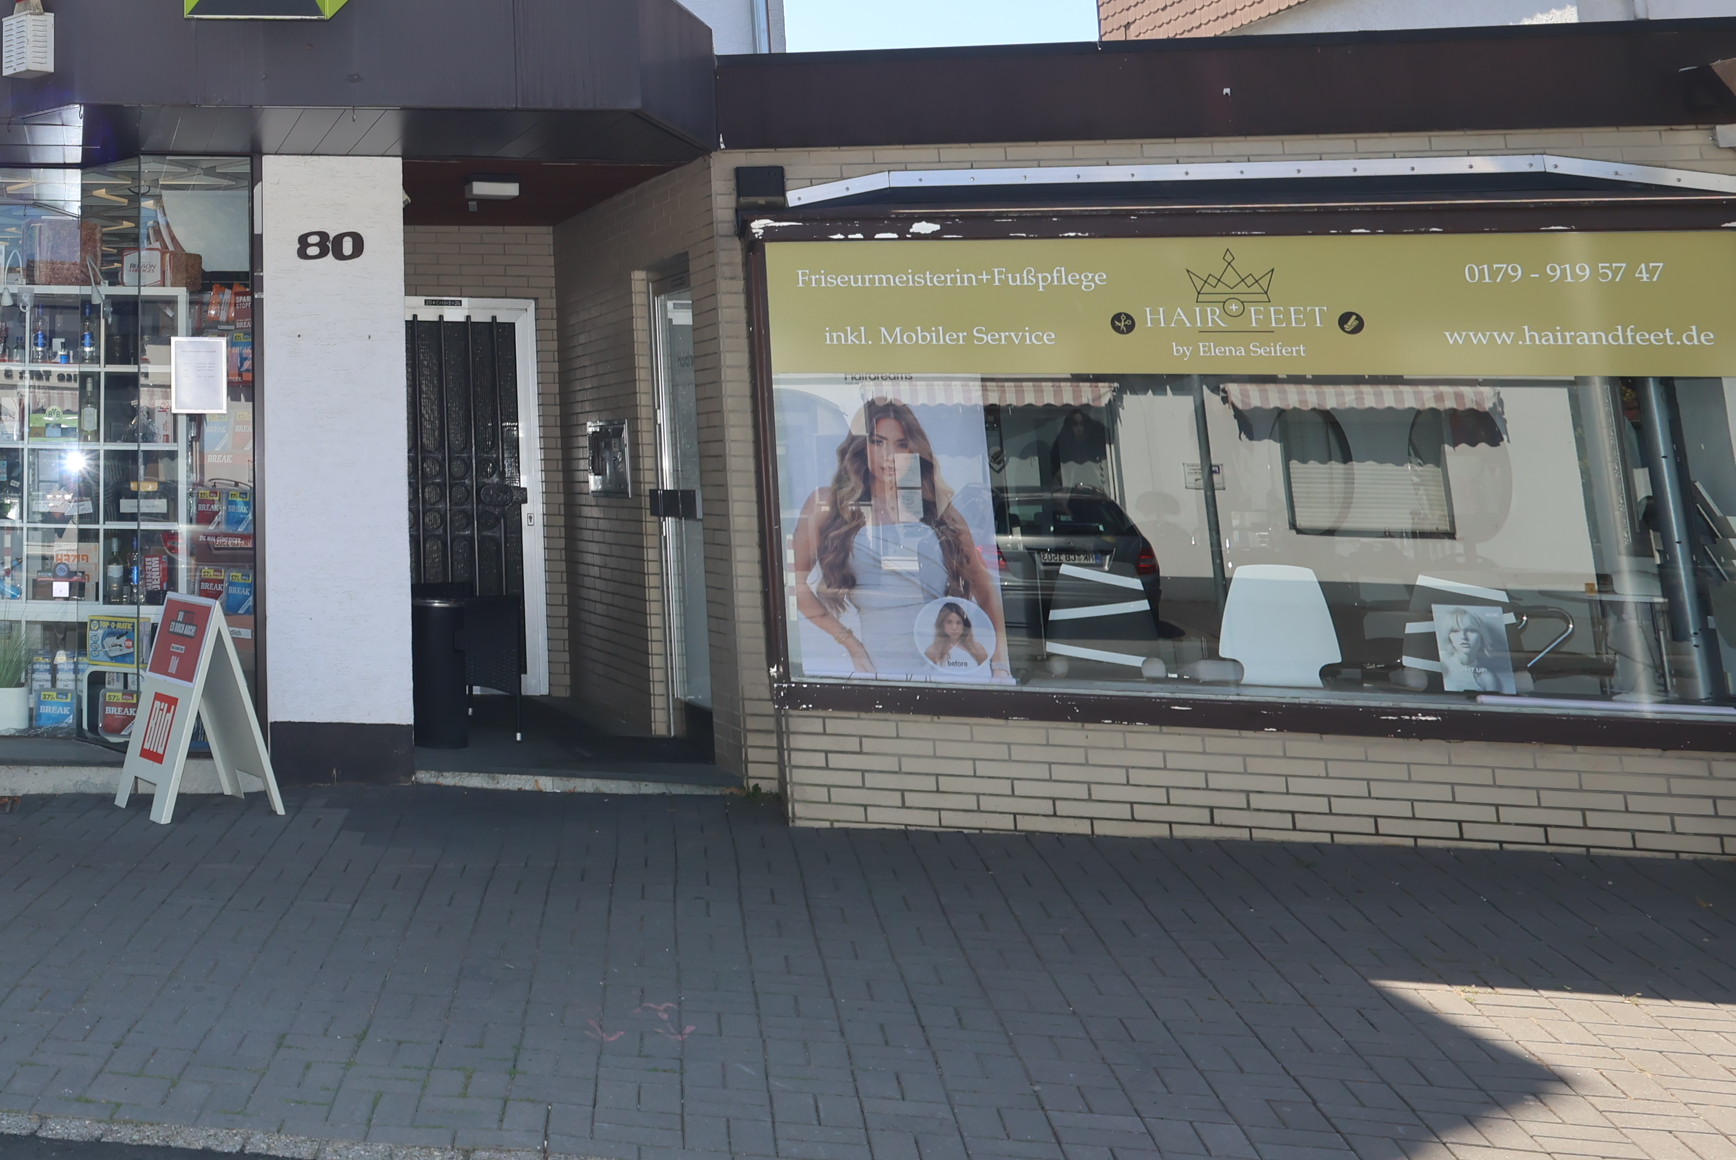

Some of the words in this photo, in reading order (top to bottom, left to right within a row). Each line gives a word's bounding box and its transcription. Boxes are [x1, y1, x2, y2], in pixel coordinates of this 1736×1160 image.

[296, 230, 365, 261] 80
[796, 267, 1108, 291] Friseurmeisterin+Fußpflege
[1464, 263, 1523, 283] 0179
[1546, 263, 1591, 283] 919
[1598, 263, 1627, 282] 57
[1635, 262, 1664, 282] 47
[1144, 307, 1229, 328] HAIR
[1249, 306, 1328, 327] FEET
[824, 326, 872, 345] inkl.
[879, 326, 967, 345] Mobiler
[973, 326, 1056, 345] Service
[1443, 325, 1715, 346] www.hairandfeet.de
[1172, 342, 1193, 360] by
[1198, 342, 1245, 356] Elena
[1249, 341, 1307, 356] Seifert
[207, 455, 233, 463] BREAK
[228, 587, 251, 596] BREAK
[39, 705, 70, 714] BREAK
[105, 706, 136, 716] BREAK
[143, 700, 176, 755] Bild
